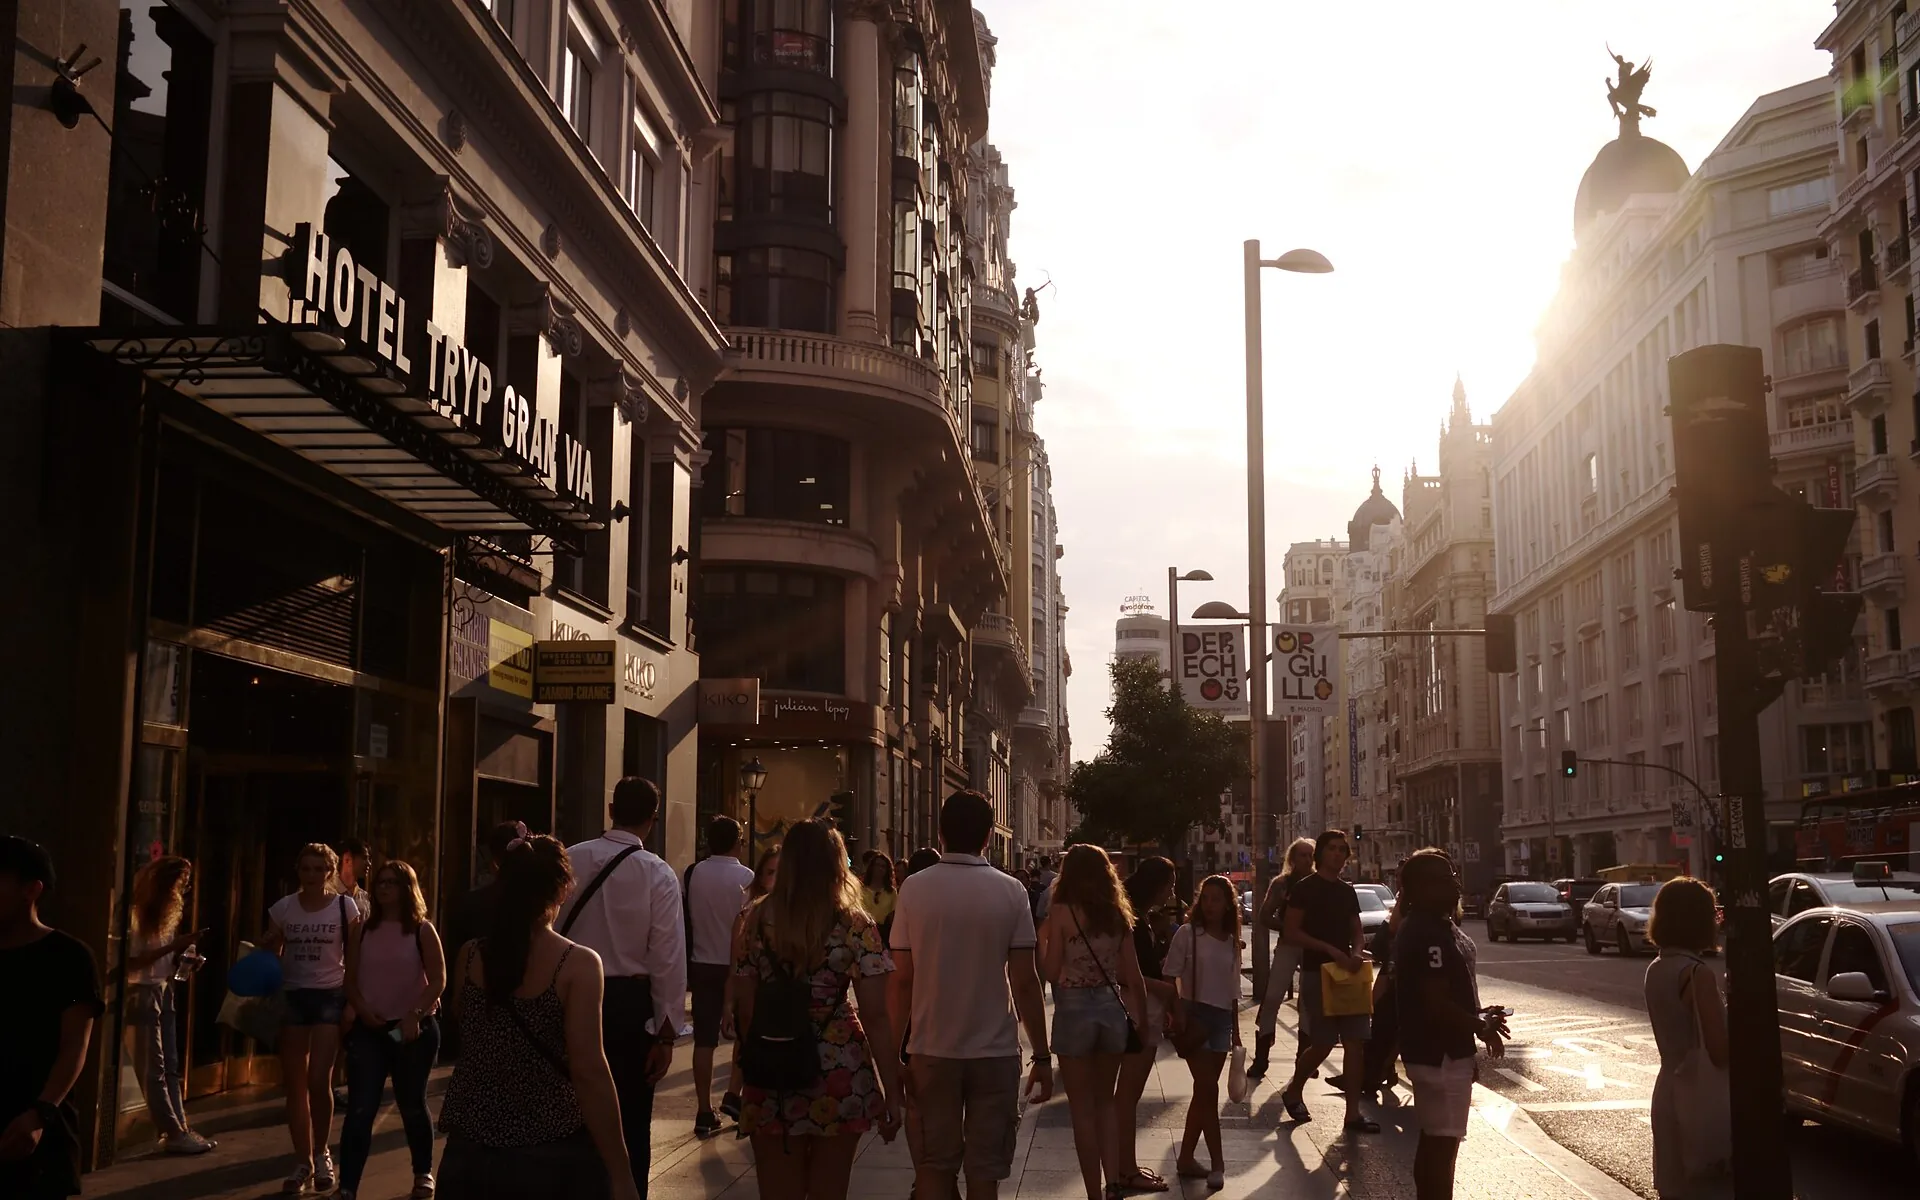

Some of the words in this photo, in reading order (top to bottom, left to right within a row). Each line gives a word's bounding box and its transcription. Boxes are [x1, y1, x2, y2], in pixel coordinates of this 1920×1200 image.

[305, 231, 411, 375] HOTEL
[427, 320, 493, 426] TRYP
[502, 385, 559, 480] GRAN
[565, 433, 594, 505] VIA
[1182, 632, 1234, 654] DER
[1275, 631, 1315, 653] OR
[624, 653, 656, 691] KIKO
[1184, 655, 1236, 678] ECH
[1288, 654, 1327, 678] GU
[704, 694, 749, 706] KIKO
[1199, 678, 1241, 701] OS
[1282, 677, 1333, 700] LLO
[1349, 700, 1357, 732] HOTEL
[1427, 945, 1443, 968] 3
